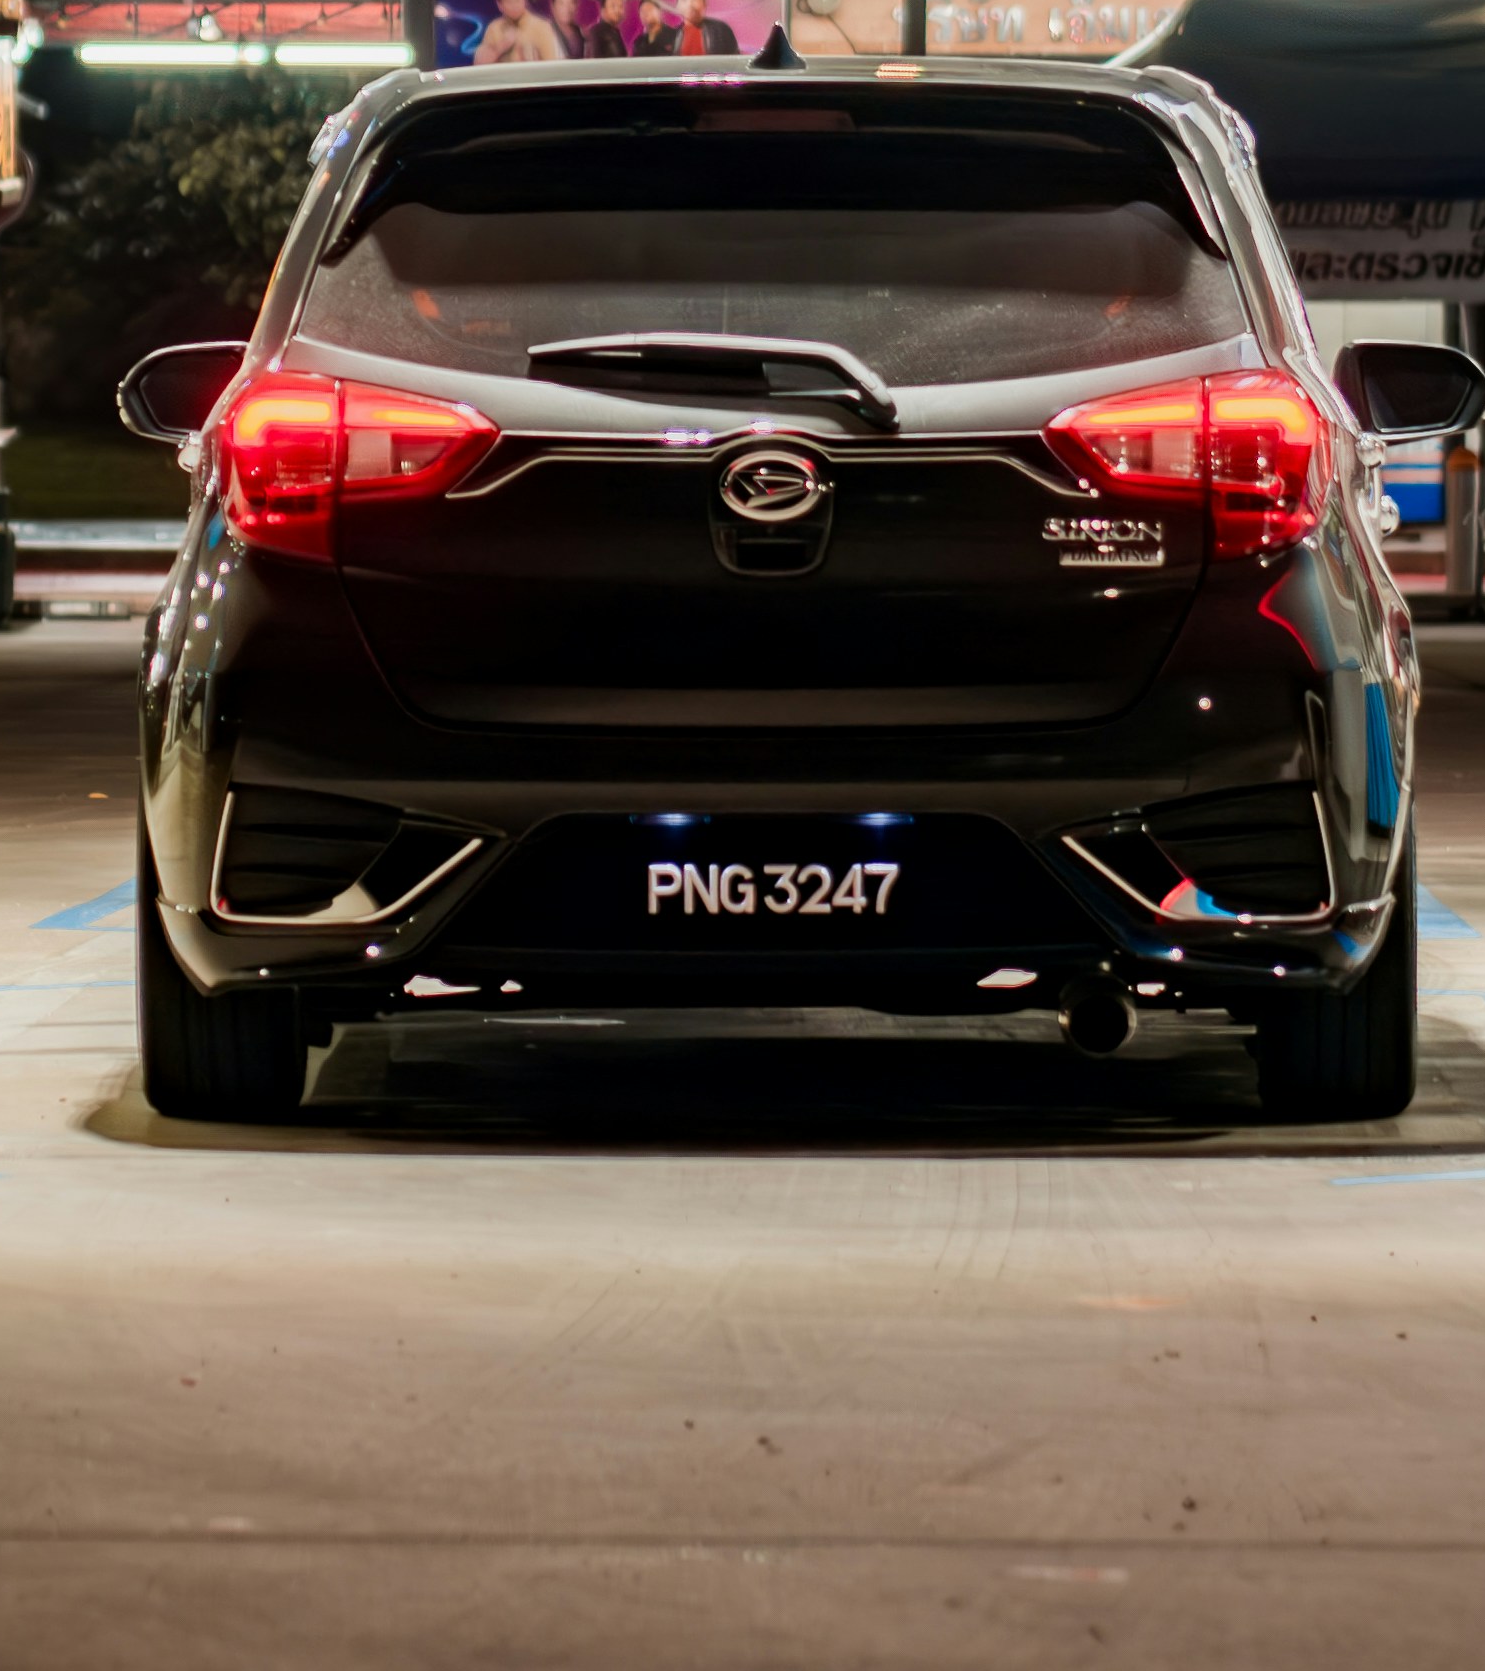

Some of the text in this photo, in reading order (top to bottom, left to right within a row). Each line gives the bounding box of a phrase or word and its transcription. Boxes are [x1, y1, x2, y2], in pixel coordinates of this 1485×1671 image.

[1042, 517, 1163, 542] SIRION
[647, 862, 900, 915] PNG 3247
